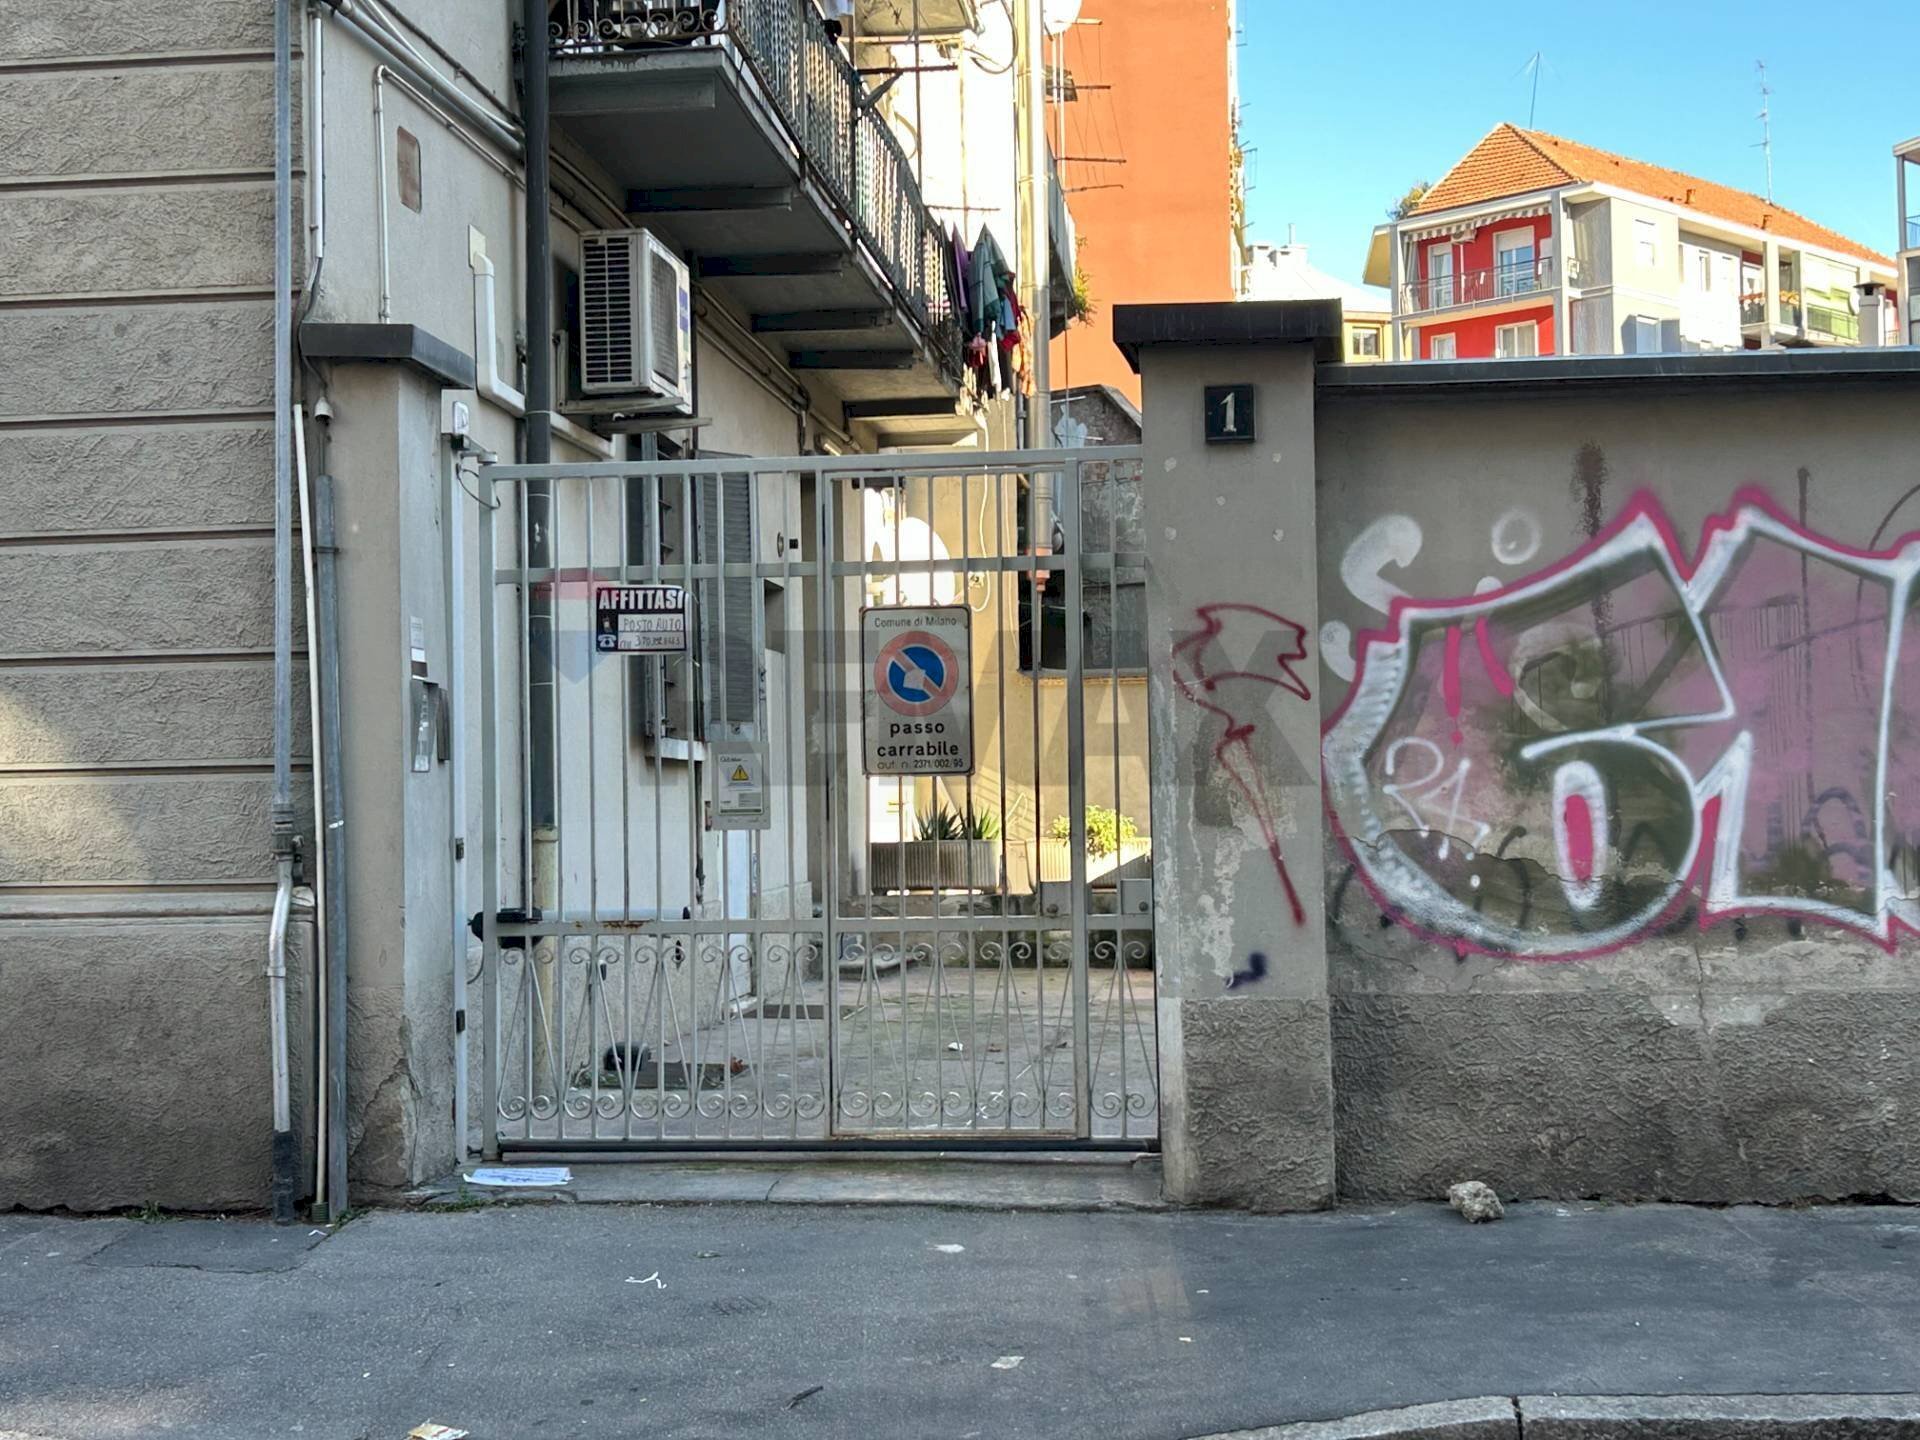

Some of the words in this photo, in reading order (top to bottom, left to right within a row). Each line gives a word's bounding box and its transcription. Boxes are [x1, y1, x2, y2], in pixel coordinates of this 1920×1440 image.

[1220, 392, 1237, 432] 1
[598, 589, 685, 611] AFFITTASI
[624, 617, 653, 632] POSTO
[656, 616, 682, 632] AUTO
[874, 617, 911, 628] Comune
[914, 616, 923, 626] di
[925, 615, 957, 627] Milano
[889, 722, 945, 738] passo
[877, 741, 959, 757] carrabile
